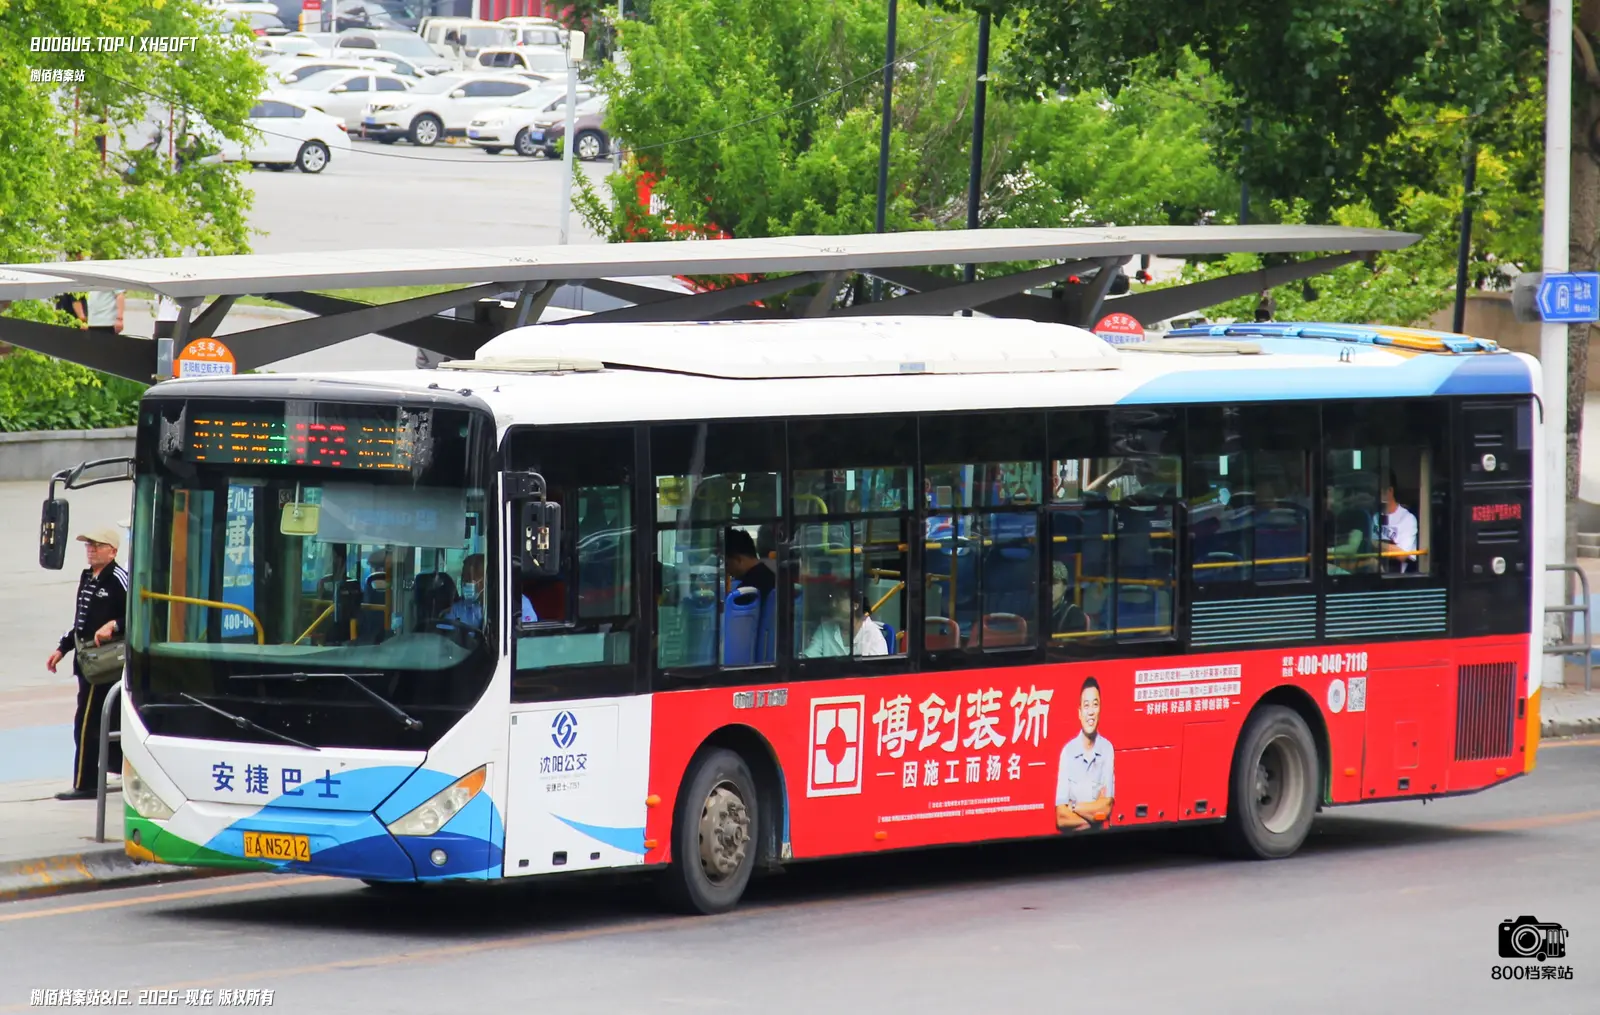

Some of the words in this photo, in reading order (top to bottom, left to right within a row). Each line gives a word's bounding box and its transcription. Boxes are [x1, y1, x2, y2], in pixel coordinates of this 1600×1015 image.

[1298, 651, 1368, 676] 400-040-7118
[872, 684, 1055, 759] 博创装饰
[1147, 702, 1168, 715] 好材料
[540, 753, 588, 774] 沈阳公交
[902, 753, 1021, 788] 因施工而扬名
[212, 761, 341, 799] 安捷巴士
